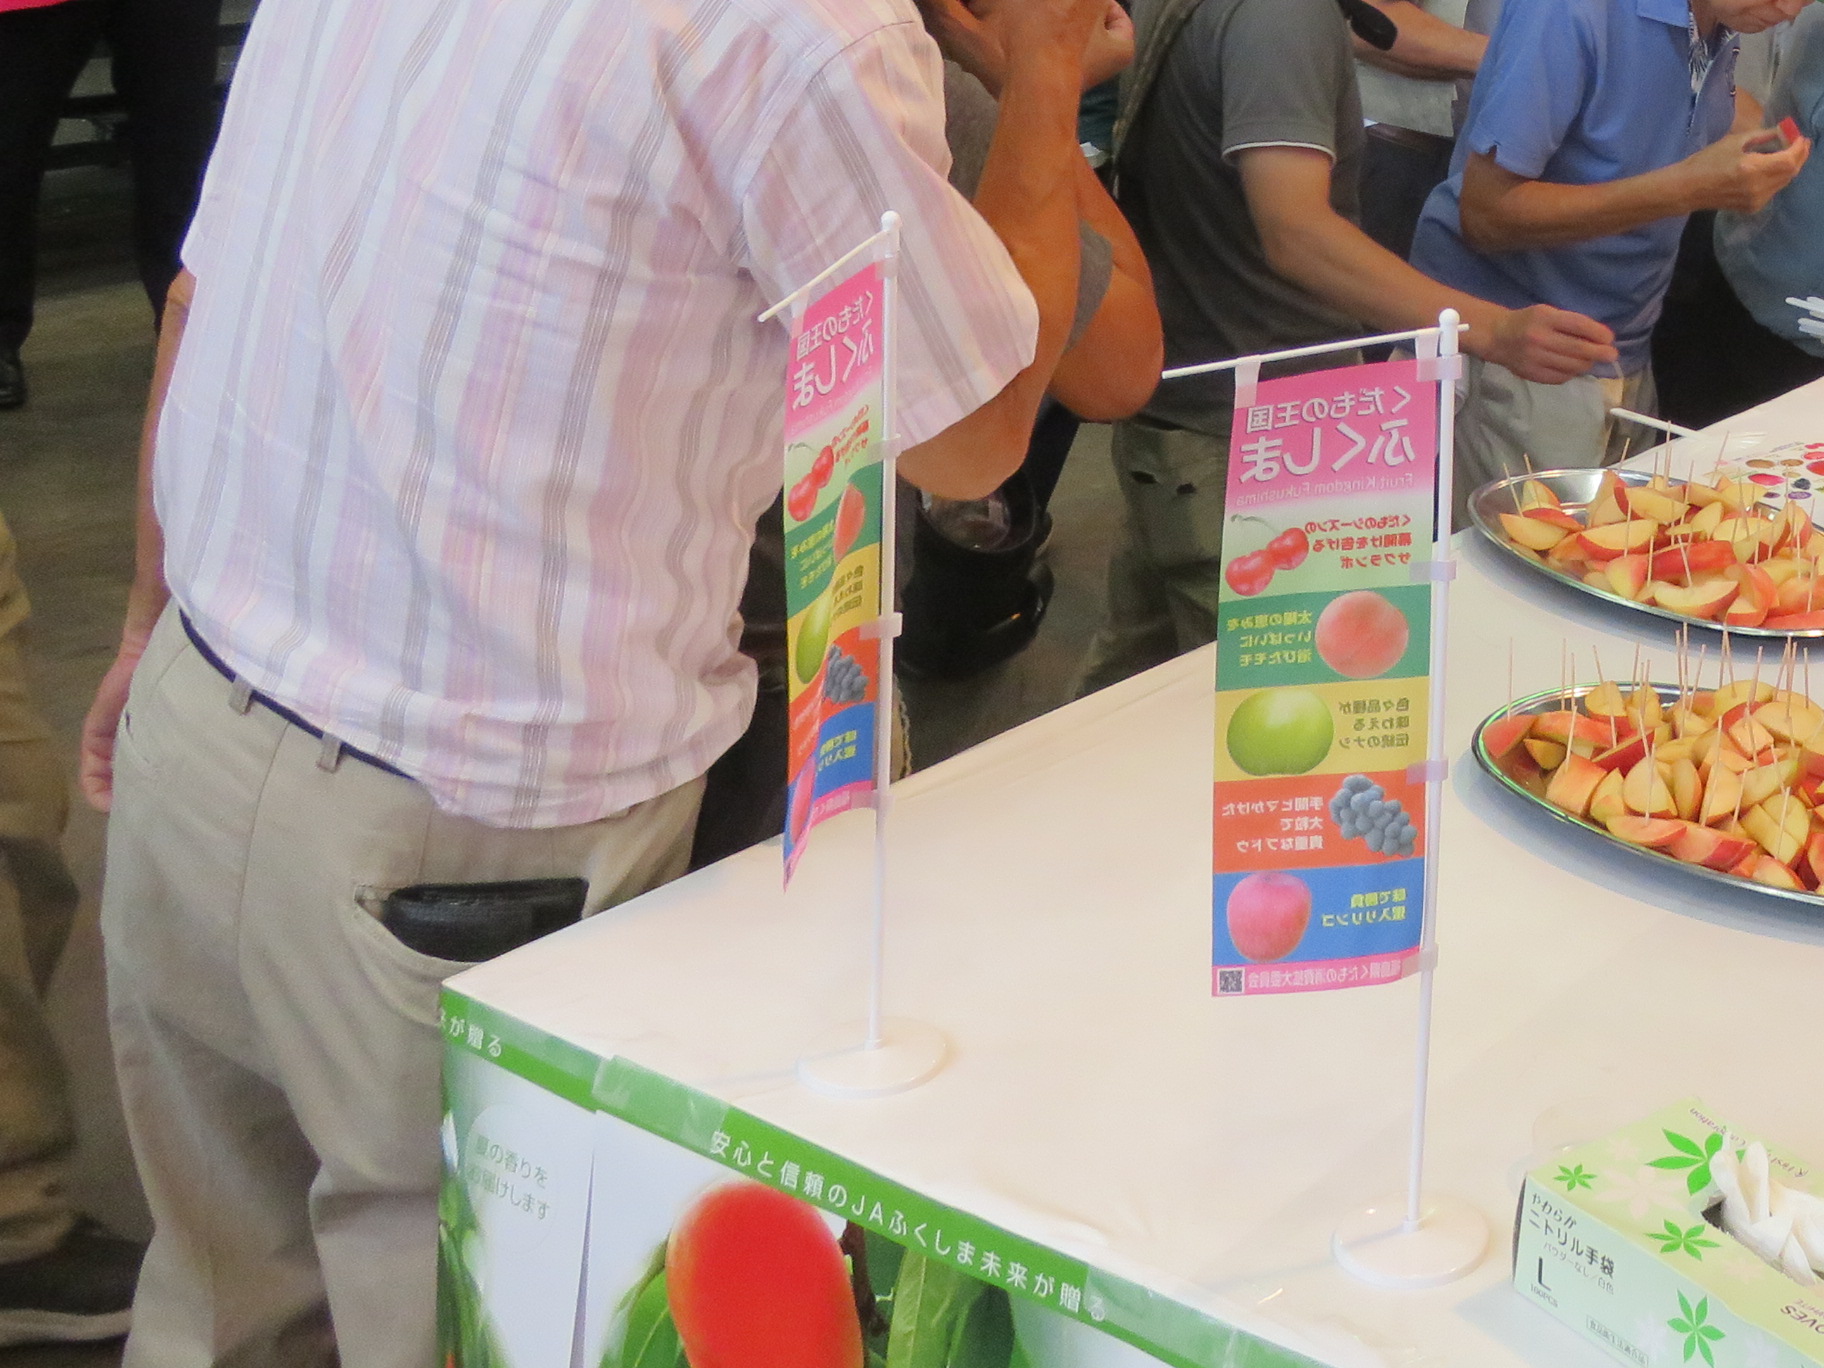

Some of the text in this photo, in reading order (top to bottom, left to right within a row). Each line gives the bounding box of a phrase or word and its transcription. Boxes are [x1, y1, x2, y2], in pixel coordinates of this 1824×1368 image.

[709, 1129, 1106, 1322] 安心と信頼のJAふくしま未来が贈る
[1532, 1192, 1577, 1230] やわらか
[1529, 1208, 1615, 1280] ニトリル手袋
[1537, 1255, 1552, 1292] L
